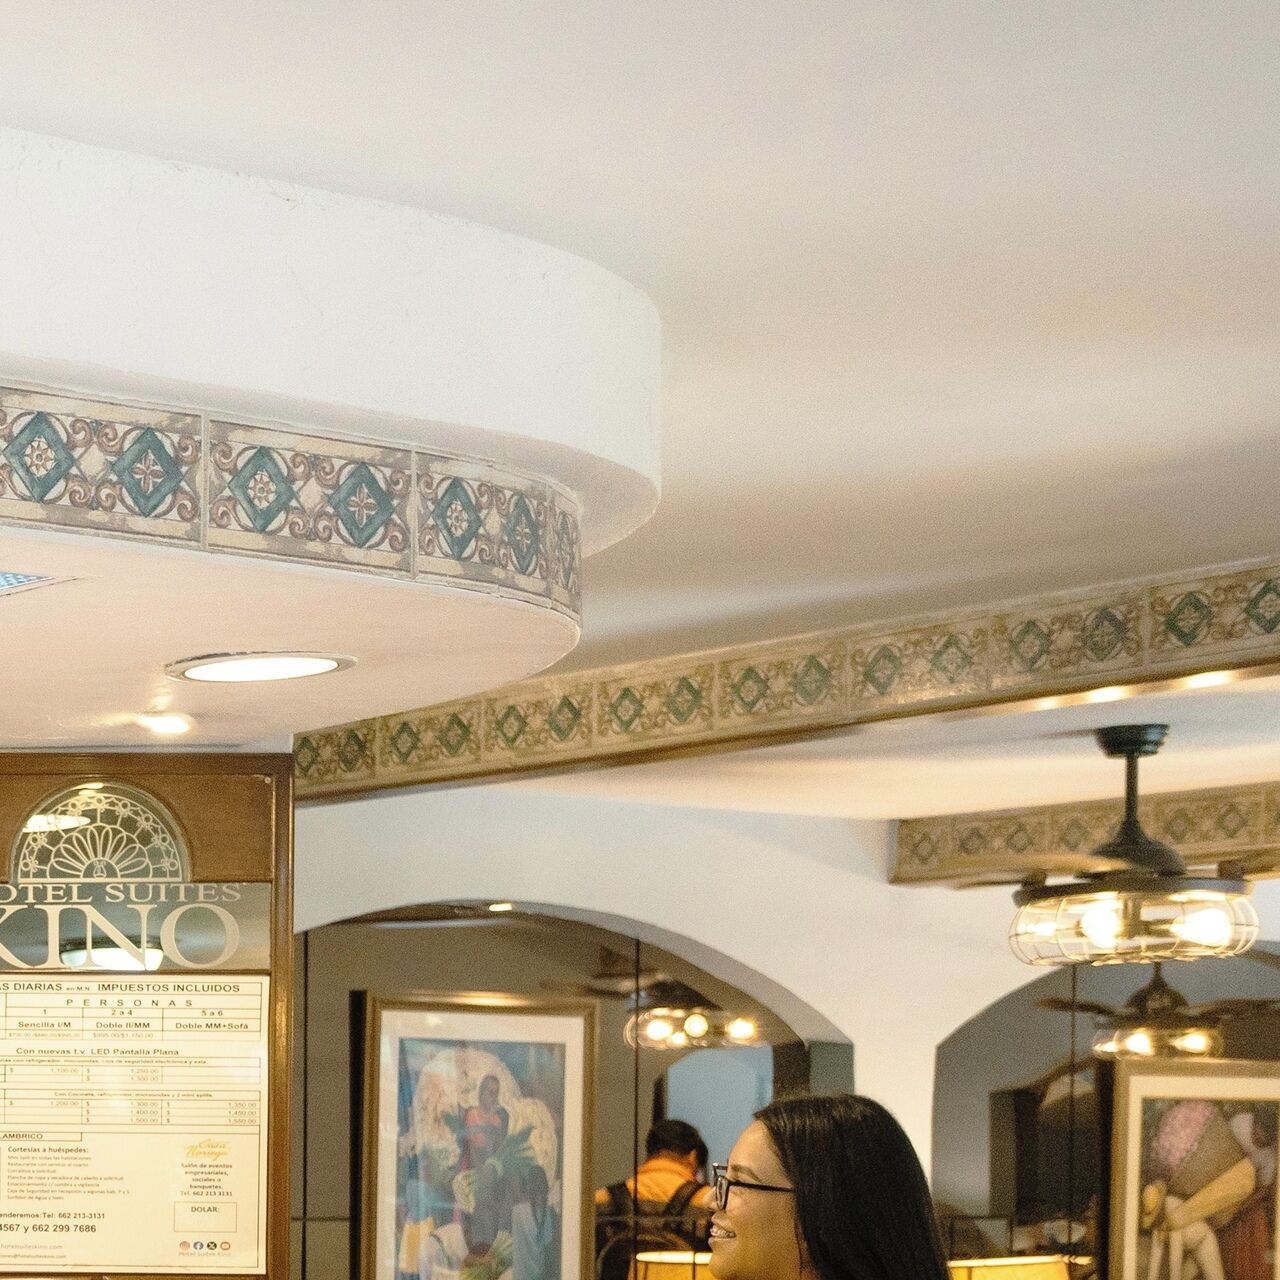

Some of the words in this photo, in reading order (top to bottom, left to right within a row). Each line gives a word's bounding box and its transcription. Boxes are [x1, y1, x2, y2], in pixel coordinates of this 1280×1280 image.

[105, 883, 241, 902] SUITES
[13, 982, 62, 991] DIARIAS
[97, 983, 169, 992] IMPUESTOS
[172, 983, 240, 992] INCLUIDOS
[95, 1021, 123, 1030] Doble
[175, 1022, 202, 1031] Doble
[15, 1047, 35, 1056] Con
[23, 1225, 29, 1233] y
[31, 1224, 49, 1232] 662
[52, 1224, 70, 1232] 299
[73, 1224, 96, 1232] 7686
